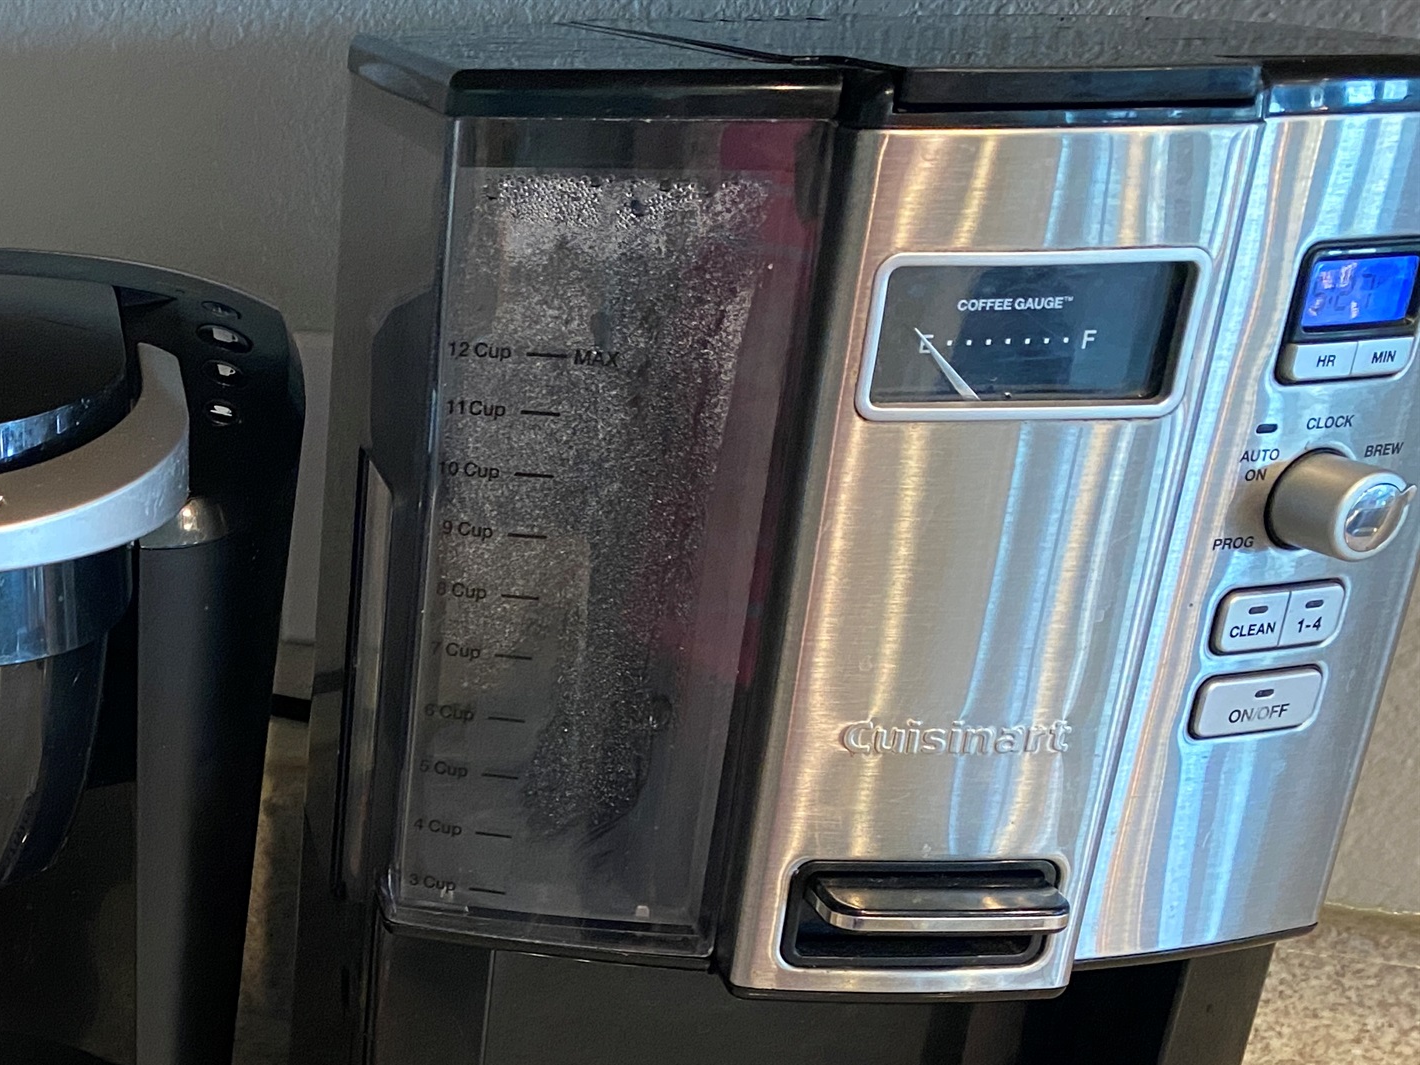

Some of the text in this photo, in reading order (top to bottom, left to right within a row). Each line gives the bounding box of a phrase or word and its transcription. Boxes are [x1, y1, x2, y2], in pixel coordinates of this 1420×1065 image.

[956, 298, 1013, 312] COFFEE
[919, 330, 1098, 354] E F
[449, 342, 620, 368] 12 Cup MAX
[1316, 350, 1397, 368] HR MIN
[1306, 414, 1355, 430] CLOCK
[1240, 448, 1280, 463] AUTO
[1364, 442, 1405, 458] BREW
[439, 461, 500, 482] 10 Cup
[1244, 468, 1267, 482] ON
[442, 520, 493, 541] 9 Cup
[1212, 536, 1255, 550] PROG
[436, 581, 487, 602] 8 Cup
[1230, 616, 1322, 638] CLEAN 1-4
[432, 641, 480, 662] 7 Cup
[424, 704, 474, 722] 6 Cup
[1228, 703, 1290, 723] ON/OFF
[838, 719, 1074, 755] Cuisinart
[419, 760, 468, 778] 5 Cup
[414, 818, 462, 838] 4 Cup
[409, 874, 456, 892] 3 Cup
